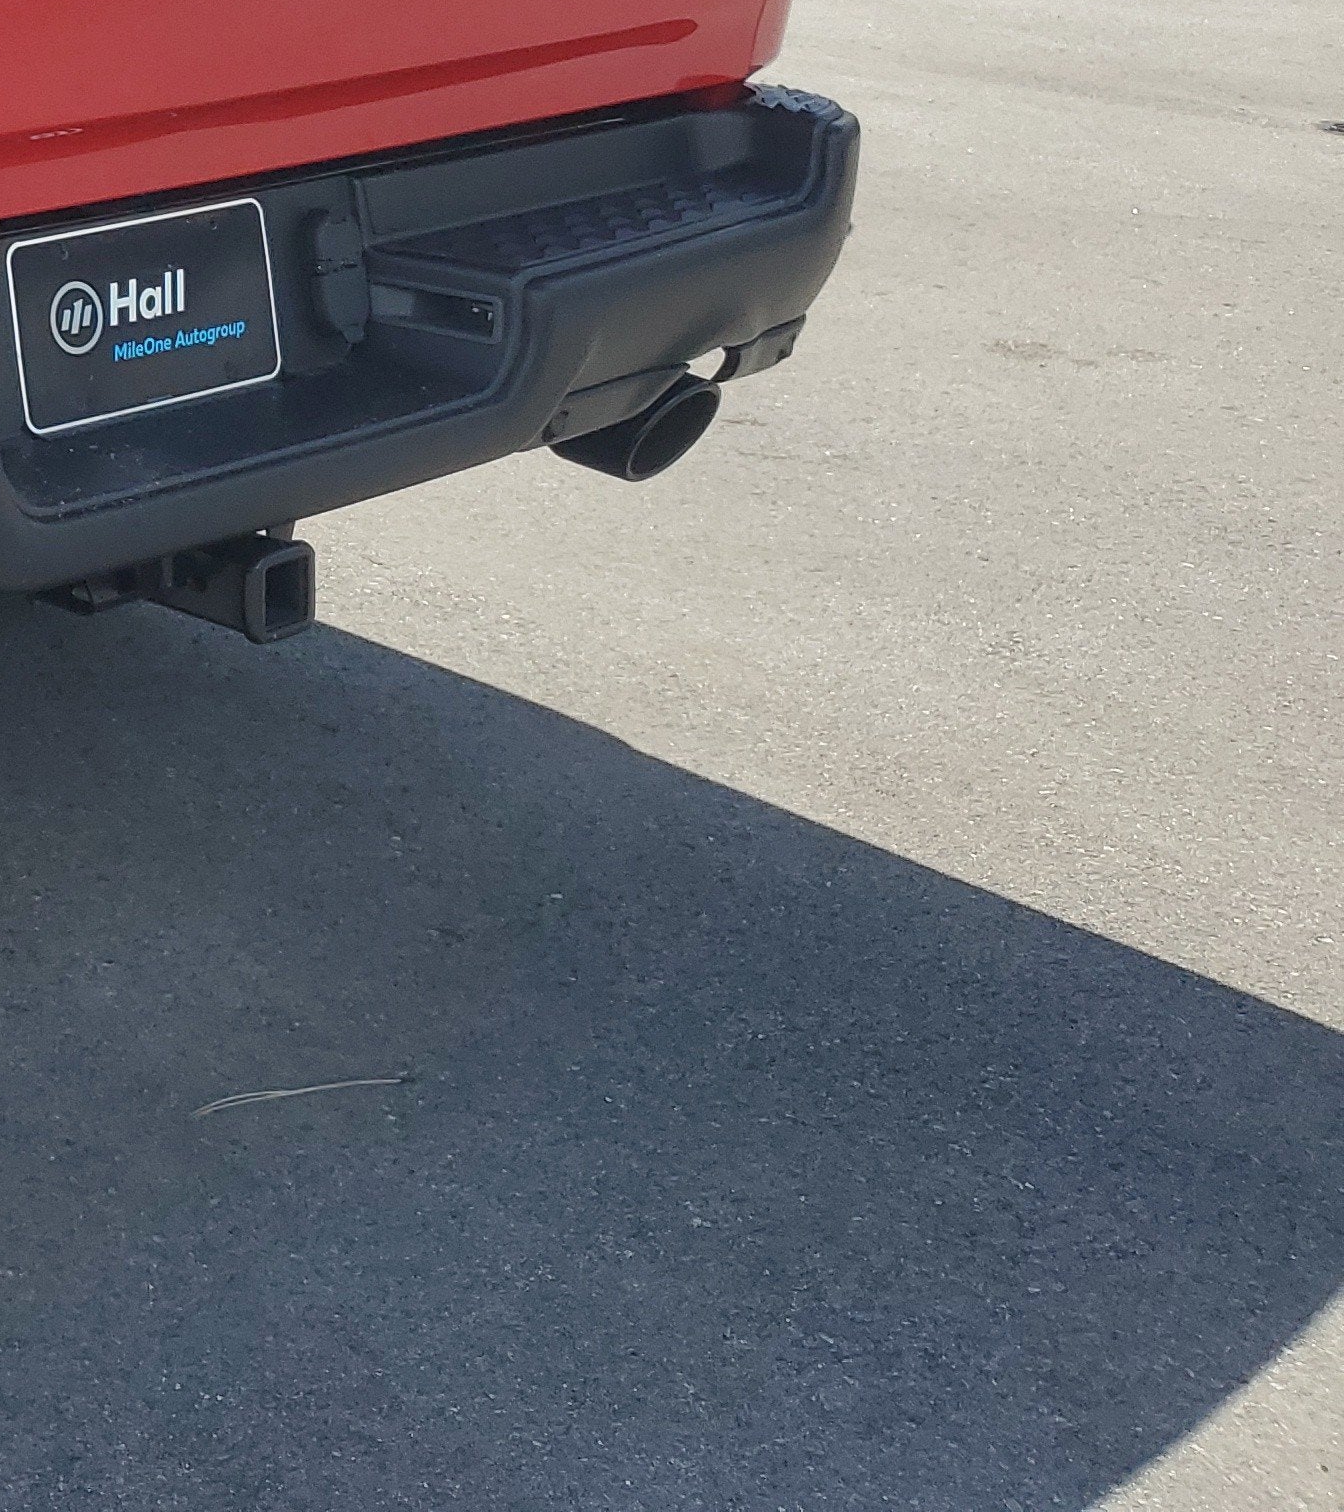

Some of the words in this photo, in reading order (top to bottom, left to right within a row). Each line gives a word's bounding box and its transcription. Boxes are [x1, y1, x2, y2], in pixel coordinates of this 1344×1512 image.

[109, 268, 186, 327] Hall
[113, 336, 172, 363] MileOne
[174, 320, 247, 349] Autogroup
